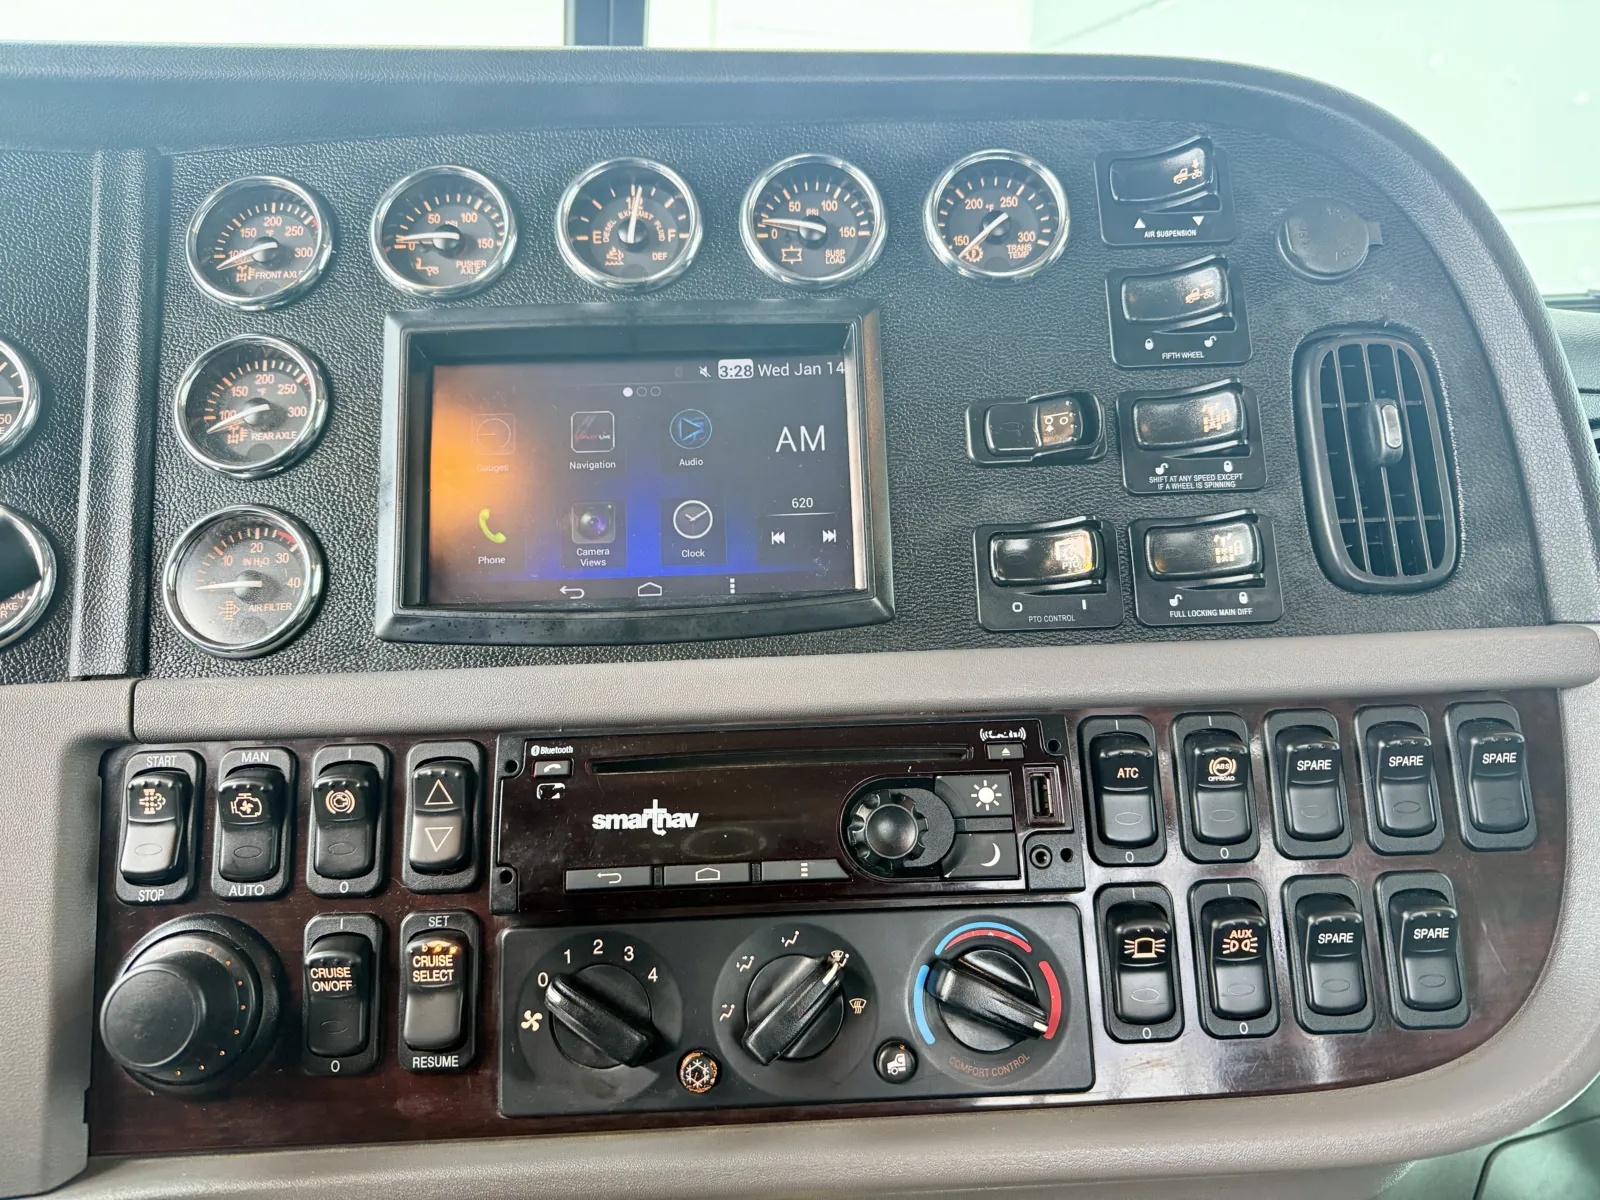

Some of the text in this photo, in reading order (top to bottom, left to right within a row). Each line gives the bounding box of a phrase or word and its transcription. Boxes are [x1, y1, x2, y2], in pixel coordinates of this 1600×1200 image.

[788, 201, 800, 212] 50
[822, 200, 838, 212] 100
[965, 199, 983, 210] 200
[1000, 196, 1018, 208] 250
[428, 213, 440, 224] 50
[461, 212, 478, 224] 100
[618, 208, 654, 220] EXHUST
[264, 216, 282, 227] 200
[240, 228, 257, 238] 150
[285, 226, 304, 238] 250
[592, 230, 602, 244] E
[668, 228, 676, 242] F
[772, 228, 778, 240] 0
[838, 226, 856, 238] 150
[1018, 232, 1036, 243] 300
[1144, 229, 1197, 238] AIR SUSPENSION
[477, 238, 494, 248] 150
[953, 235, 970, 246] 150
[294, 248, 314, 258] 300
[1007, 244, 1032, 252] TRANS
[652, 252, 668, 261] DEF
[826, 250, 846, 258] SUSP
[1008, 252, 1029, 260] TEMP
[456, 260, 487, 268] PUSHER
[826, 256, 846, 264] LOAD
[256, 272, 282, 280] FRONT
[460, 267, 480, 275] AXLE
[1182, 352, 1205, 360] WHEEL
[720, 365, 752, 378] 3:28
[758, 362, 844, 376] Wed Jan 14
[256, 374, 274, 384] 200
[232, 386, 248, 397] 150
[277, 384, 297, 395] 250
[288, 406, 307, 418] 300
[252, 431, 298, 441] REAR AXLE
[776, 425, 826, 452] AM
[569, 461, 616, 470] Navigation
[679, 458, 704, 466] Audio
[477, 464, 509, 472] Gauges
[1148, 476, 1168, 484] SHIFT
[792, 498, 814, 508] 620
[250, 542, 264, 553] 20
[576, 548, 610, 556] Camera
[276, 552, 290, 564] 30
[682, 549, 706, 558] Clock
[222, 556, 232, 566] 10
[243, 558, 252, 566] IN
[478, 556, 506, 564] Phone
[580, 558, 606, 567] Views
[1062, 562, 1080, 570] PTO
[287, 578, 300, 588] 40
[264, 603, 292, 612] FILTER
[1188, 609, 1218, 617] LOCKING
[1237, 608, 1254, 616] DIFF
[540, 745, 574, 754] Bluetooth
[146, 755, 177, 768] START
[241, 751, 270, 763] MAN
[1388, 756, 1424, 768] SPARE
[1482, 752, 1517, 764] SPARE
[1296, 760, 1332, 772] SPARE
[1117, 767, 1140, 778] ATC
[592, 799, 699, 836] smartnav
[138, 889, 164, 902] STOP
[229, 884, 265, 897] AUTO
[428, 916, 450, 927] SET
[1230, 929, 1252, 938] AUX
[1318, 932, 1354, 944] SPARE
[1413, 928, 1450, 940] SPARE
[593, 939, 604, 955] 2
[564, 948, 571, 964] 1
[624, 946, 634, 962] 3
[412, 955, 454, 967] CRUISE
[310, 966, 352, 979] CRUISE
[412, 970, 454, 982] SELECT
[648, 967, 658, 982] 4
[538, 972, 549, 988] 0
[312, 980, 352, 992] ON/OFF
[412, 1056, 459, 1068] RESUME
[949, 1053, 1030, 1077] COMFORT CONTROL
